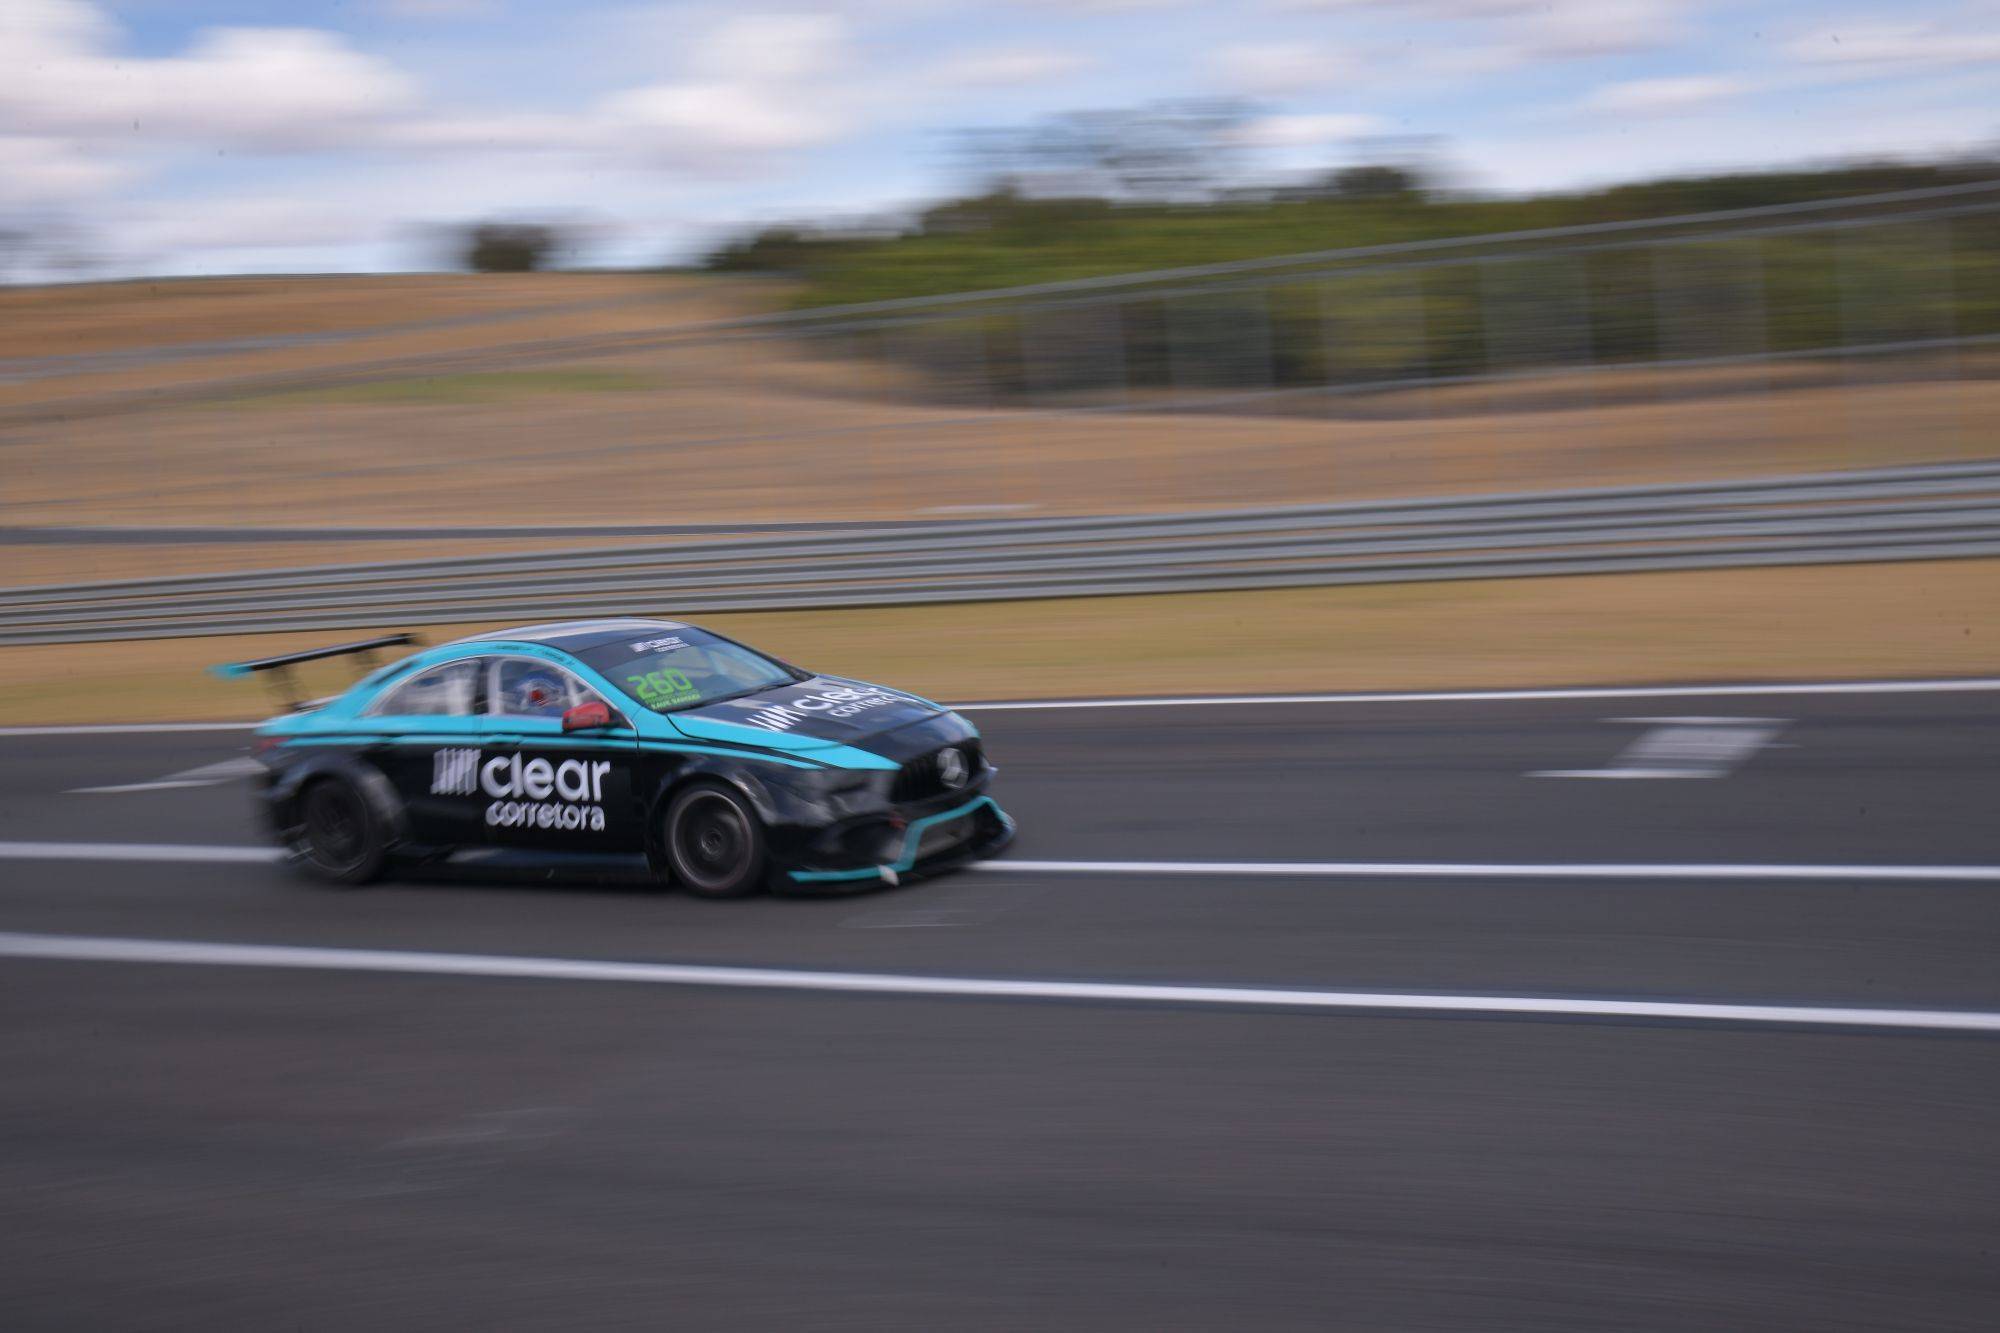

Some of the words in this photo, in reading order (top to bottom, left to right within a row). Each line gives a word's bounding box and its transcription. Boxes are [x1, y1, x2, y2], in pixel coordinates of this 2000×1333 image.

[627, 669, 693, 699] 260
[480, 751, 610, 801] clear
[485, 800, 605, 831] corretora
